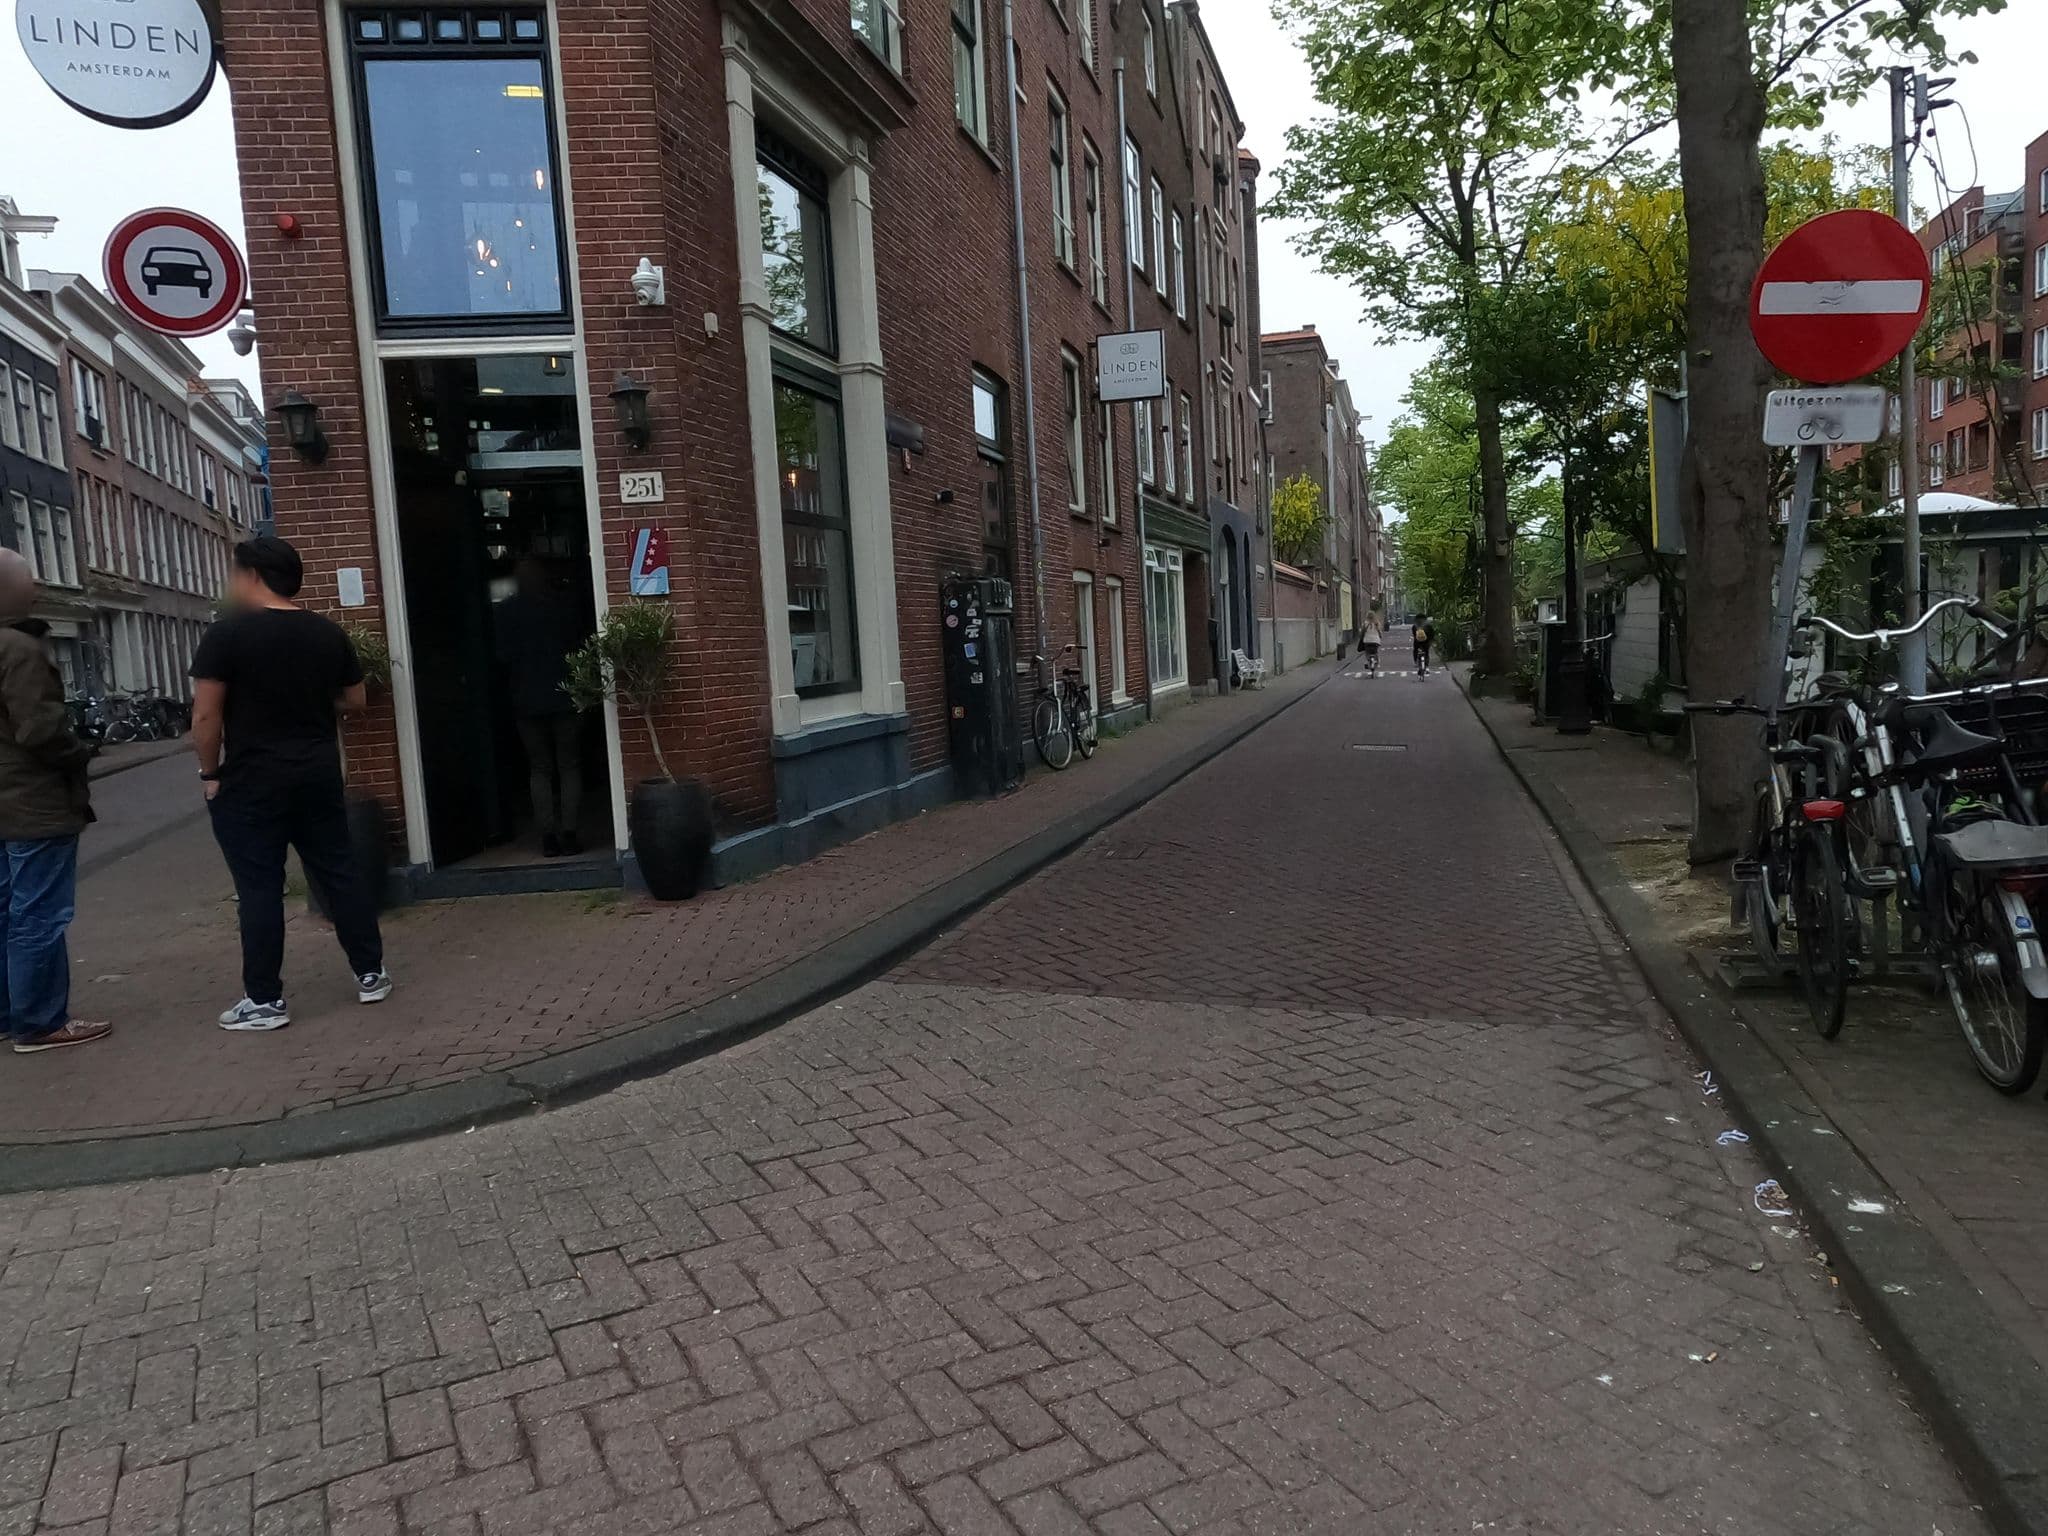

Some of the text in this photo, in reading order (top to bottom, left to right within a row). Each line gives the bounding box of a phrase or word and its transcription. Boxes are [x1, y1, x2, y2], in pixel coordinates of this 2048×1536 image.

[30, 14, 200, 55] LINDEN
[66, 61, 171, 79] AMSTERDAM
[1102, 360, 1159, 375] LINDEN
[1773, 394, 1880, 409] uitgezon
[625, 476, 658, 498] 251
